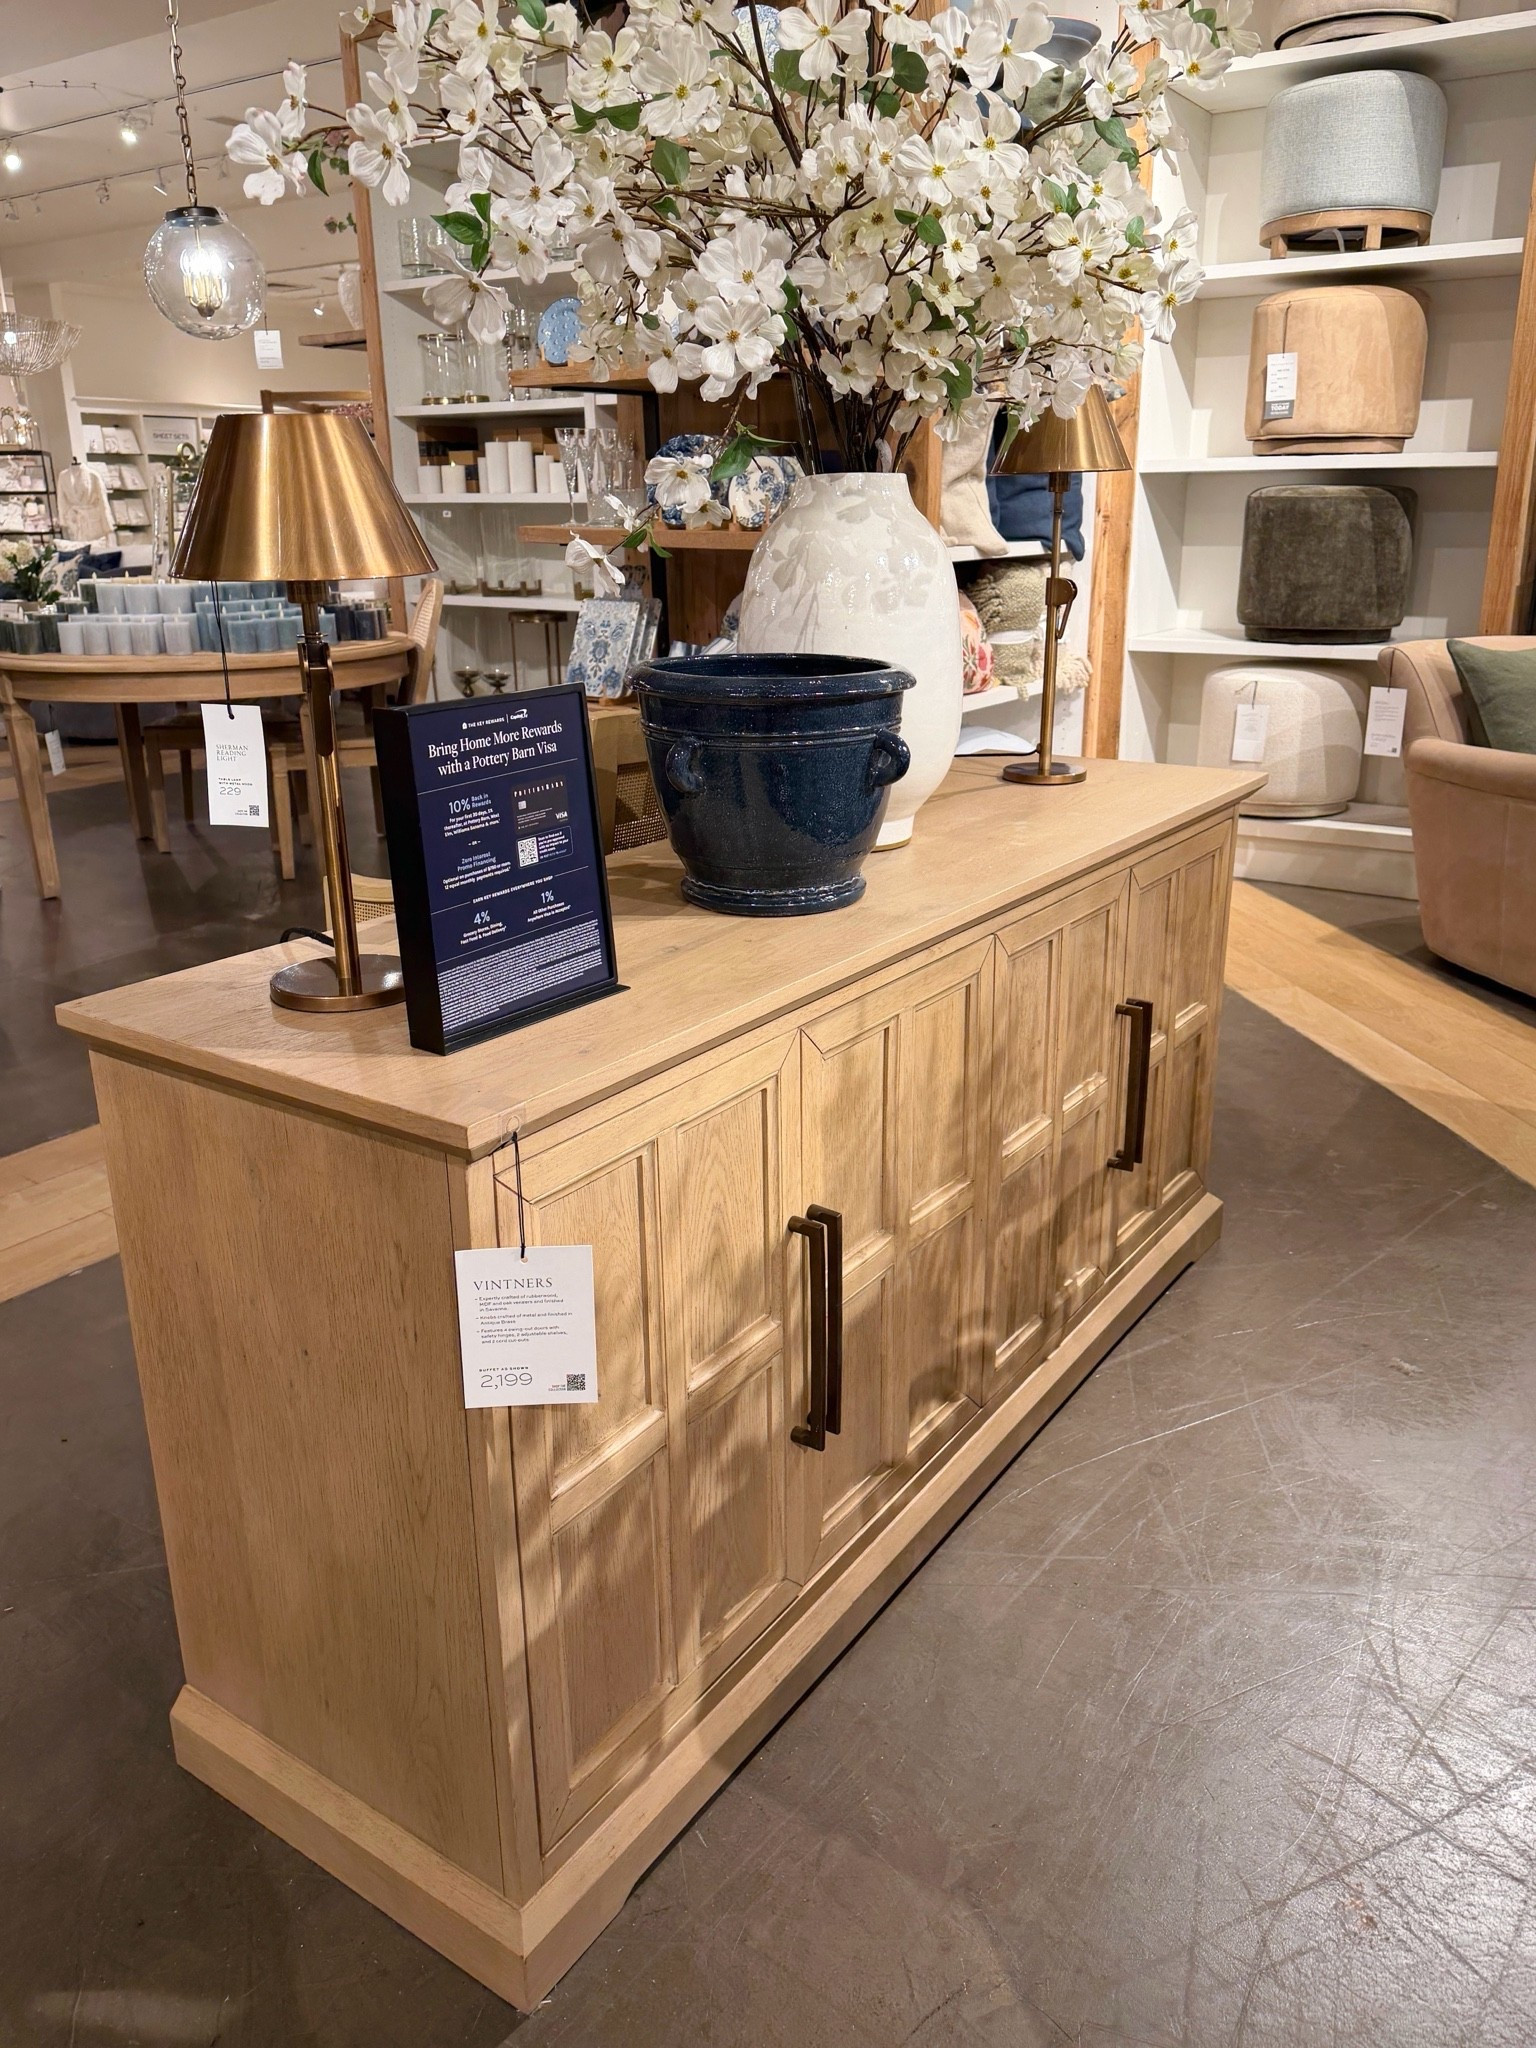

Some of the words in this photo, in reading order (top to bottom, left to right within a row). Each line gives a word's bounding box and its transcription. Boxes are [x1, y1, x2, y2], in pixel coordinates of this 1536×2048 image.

[428, 742, 458, 758] Bring
[460, 736, 491, 752] Home
[493, 731, 520, 745] More
[521, 720, 562, 739] Rewards
[438, 759, 462, 776] with
[464, 761, 470, 770] a
[472, 752, 509, 768] Pottery
[512, 746, 535, 760] Barn
[536, 741, 557, 754] Visa
[220, 787, 241, 795] 229
[449, 798, 470, 814] 10%
[472, 799, 491, 808] Rewards
[555, 811, 567, 819] VISA
[473, 852, 490, 861] Interest
[473, 856, 496, 867] Financing
[443, 876, 459, 884] Optional
[492, 888, 510, 898] REWARDS
[511, 881, 535, 892] EVERYWHERE
[541, 890, 554, 903] 1%
[474, 910, 490, 924] 4%
[474, 1278, 552, 1290] VINTNERS
[481, 1372, 532, 1390] 2,199
